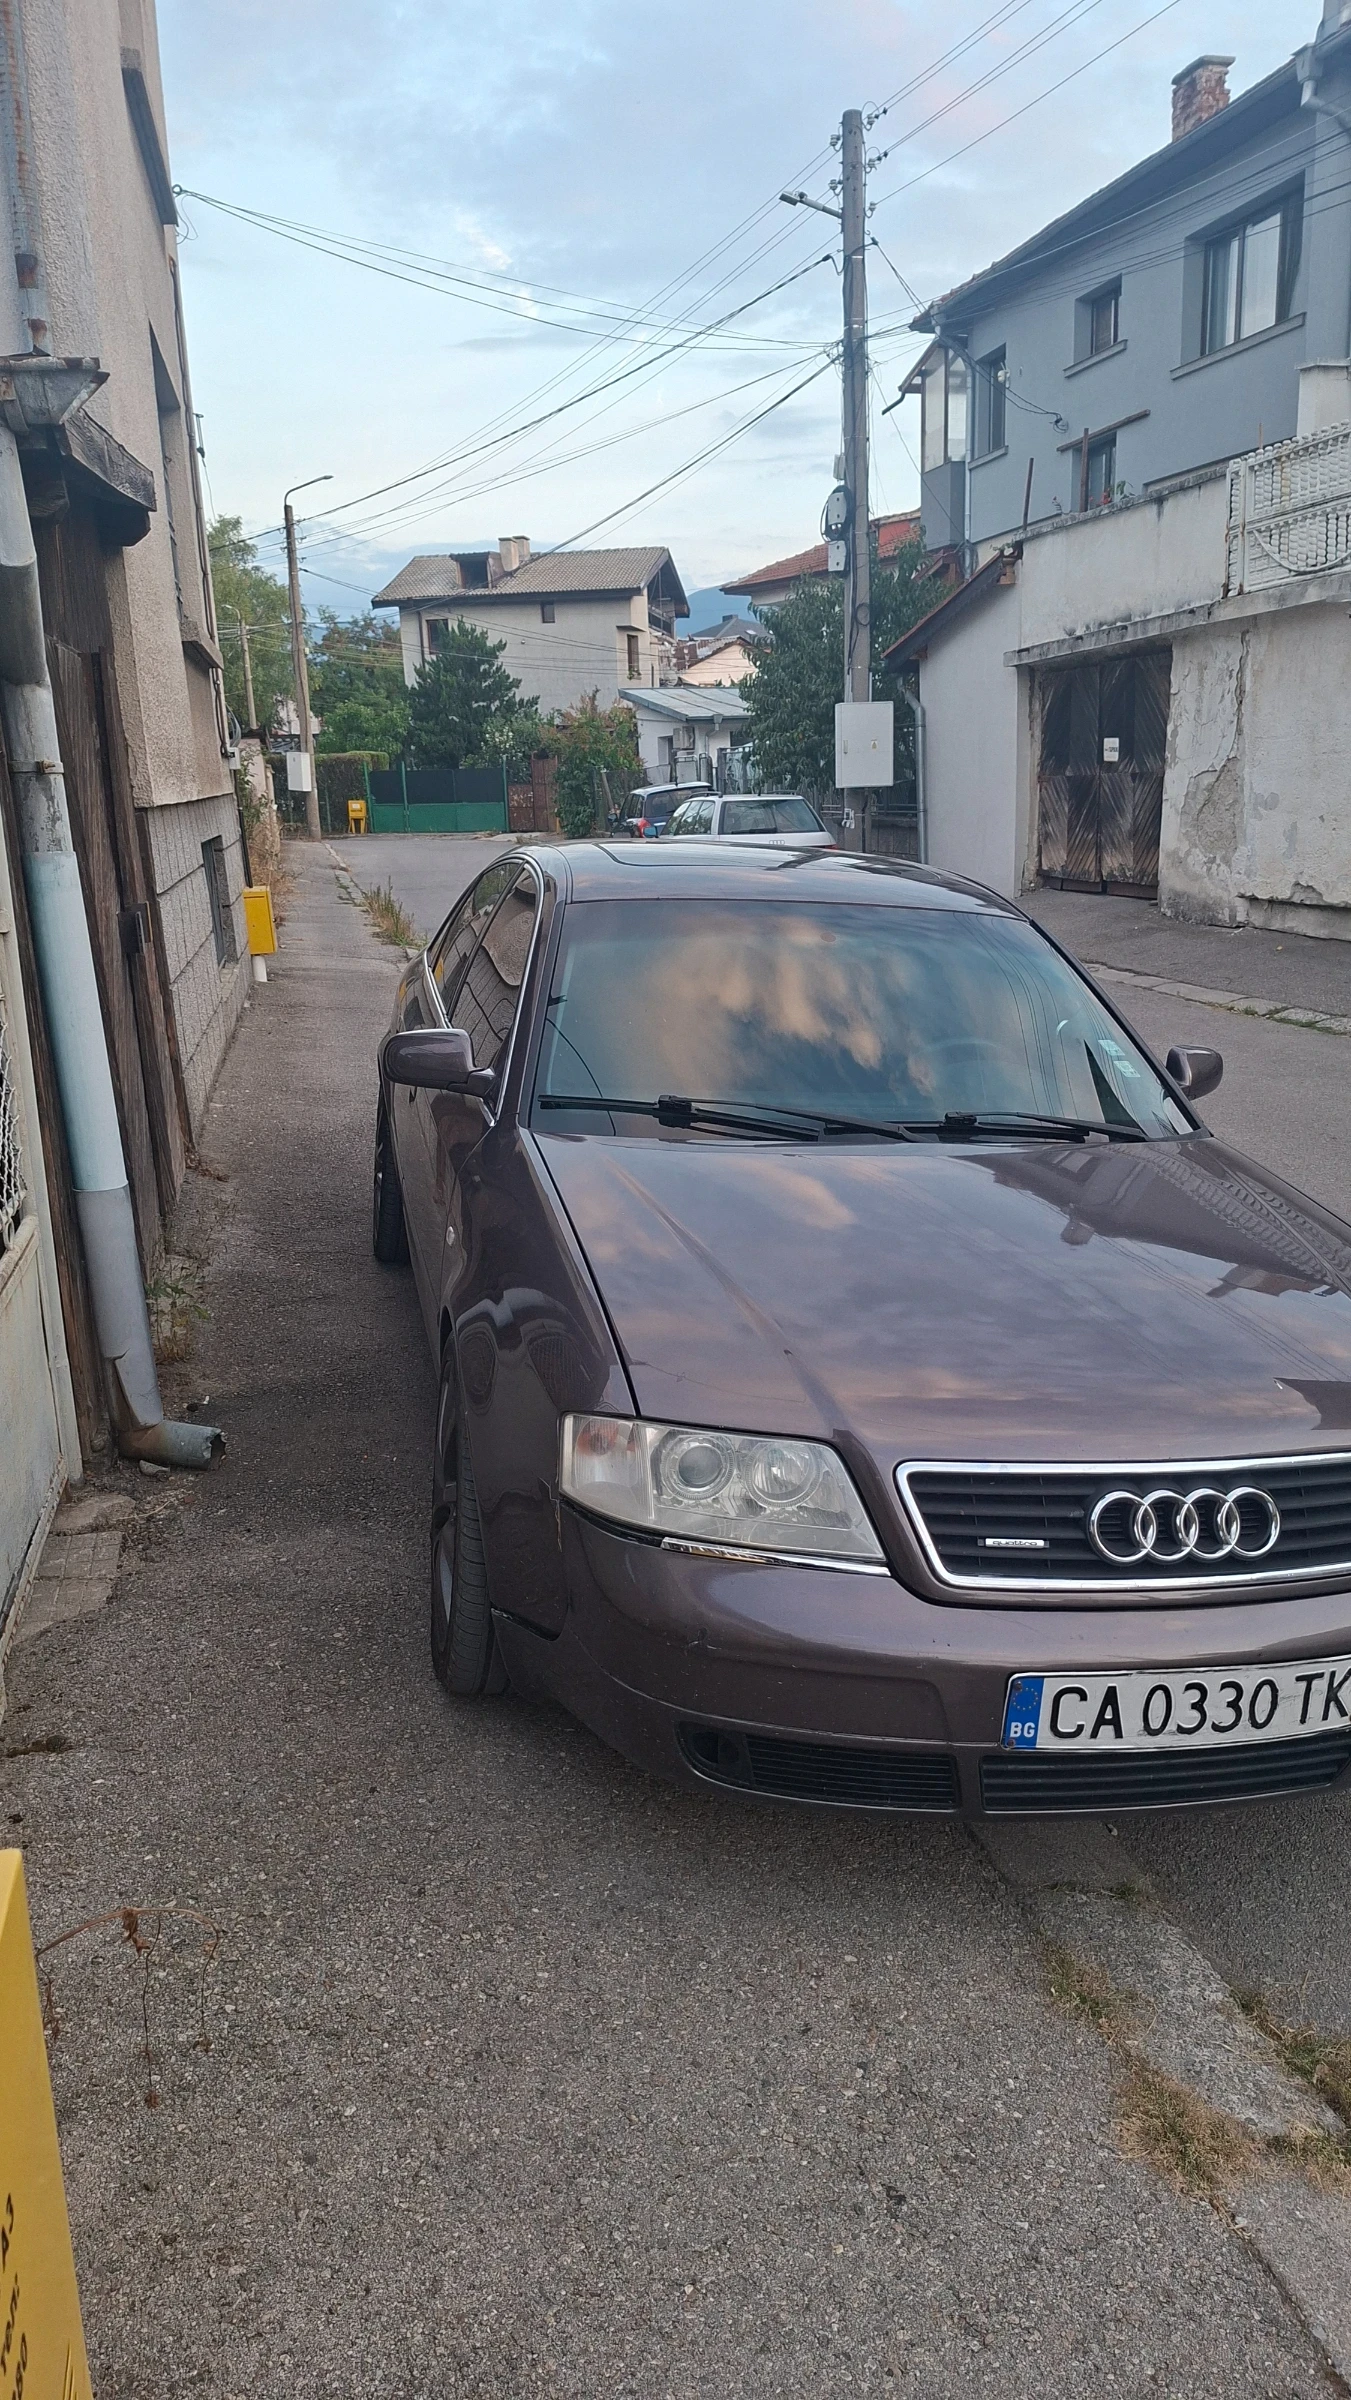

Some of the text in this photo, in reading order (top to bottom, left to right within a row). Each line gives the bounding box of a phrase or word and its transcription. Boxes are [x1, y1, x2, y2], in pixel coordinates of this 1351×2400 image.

[1050, 1667, 1351, 1740] CA 0330 TK
[1010, 1721, 1036, 1738] BG
